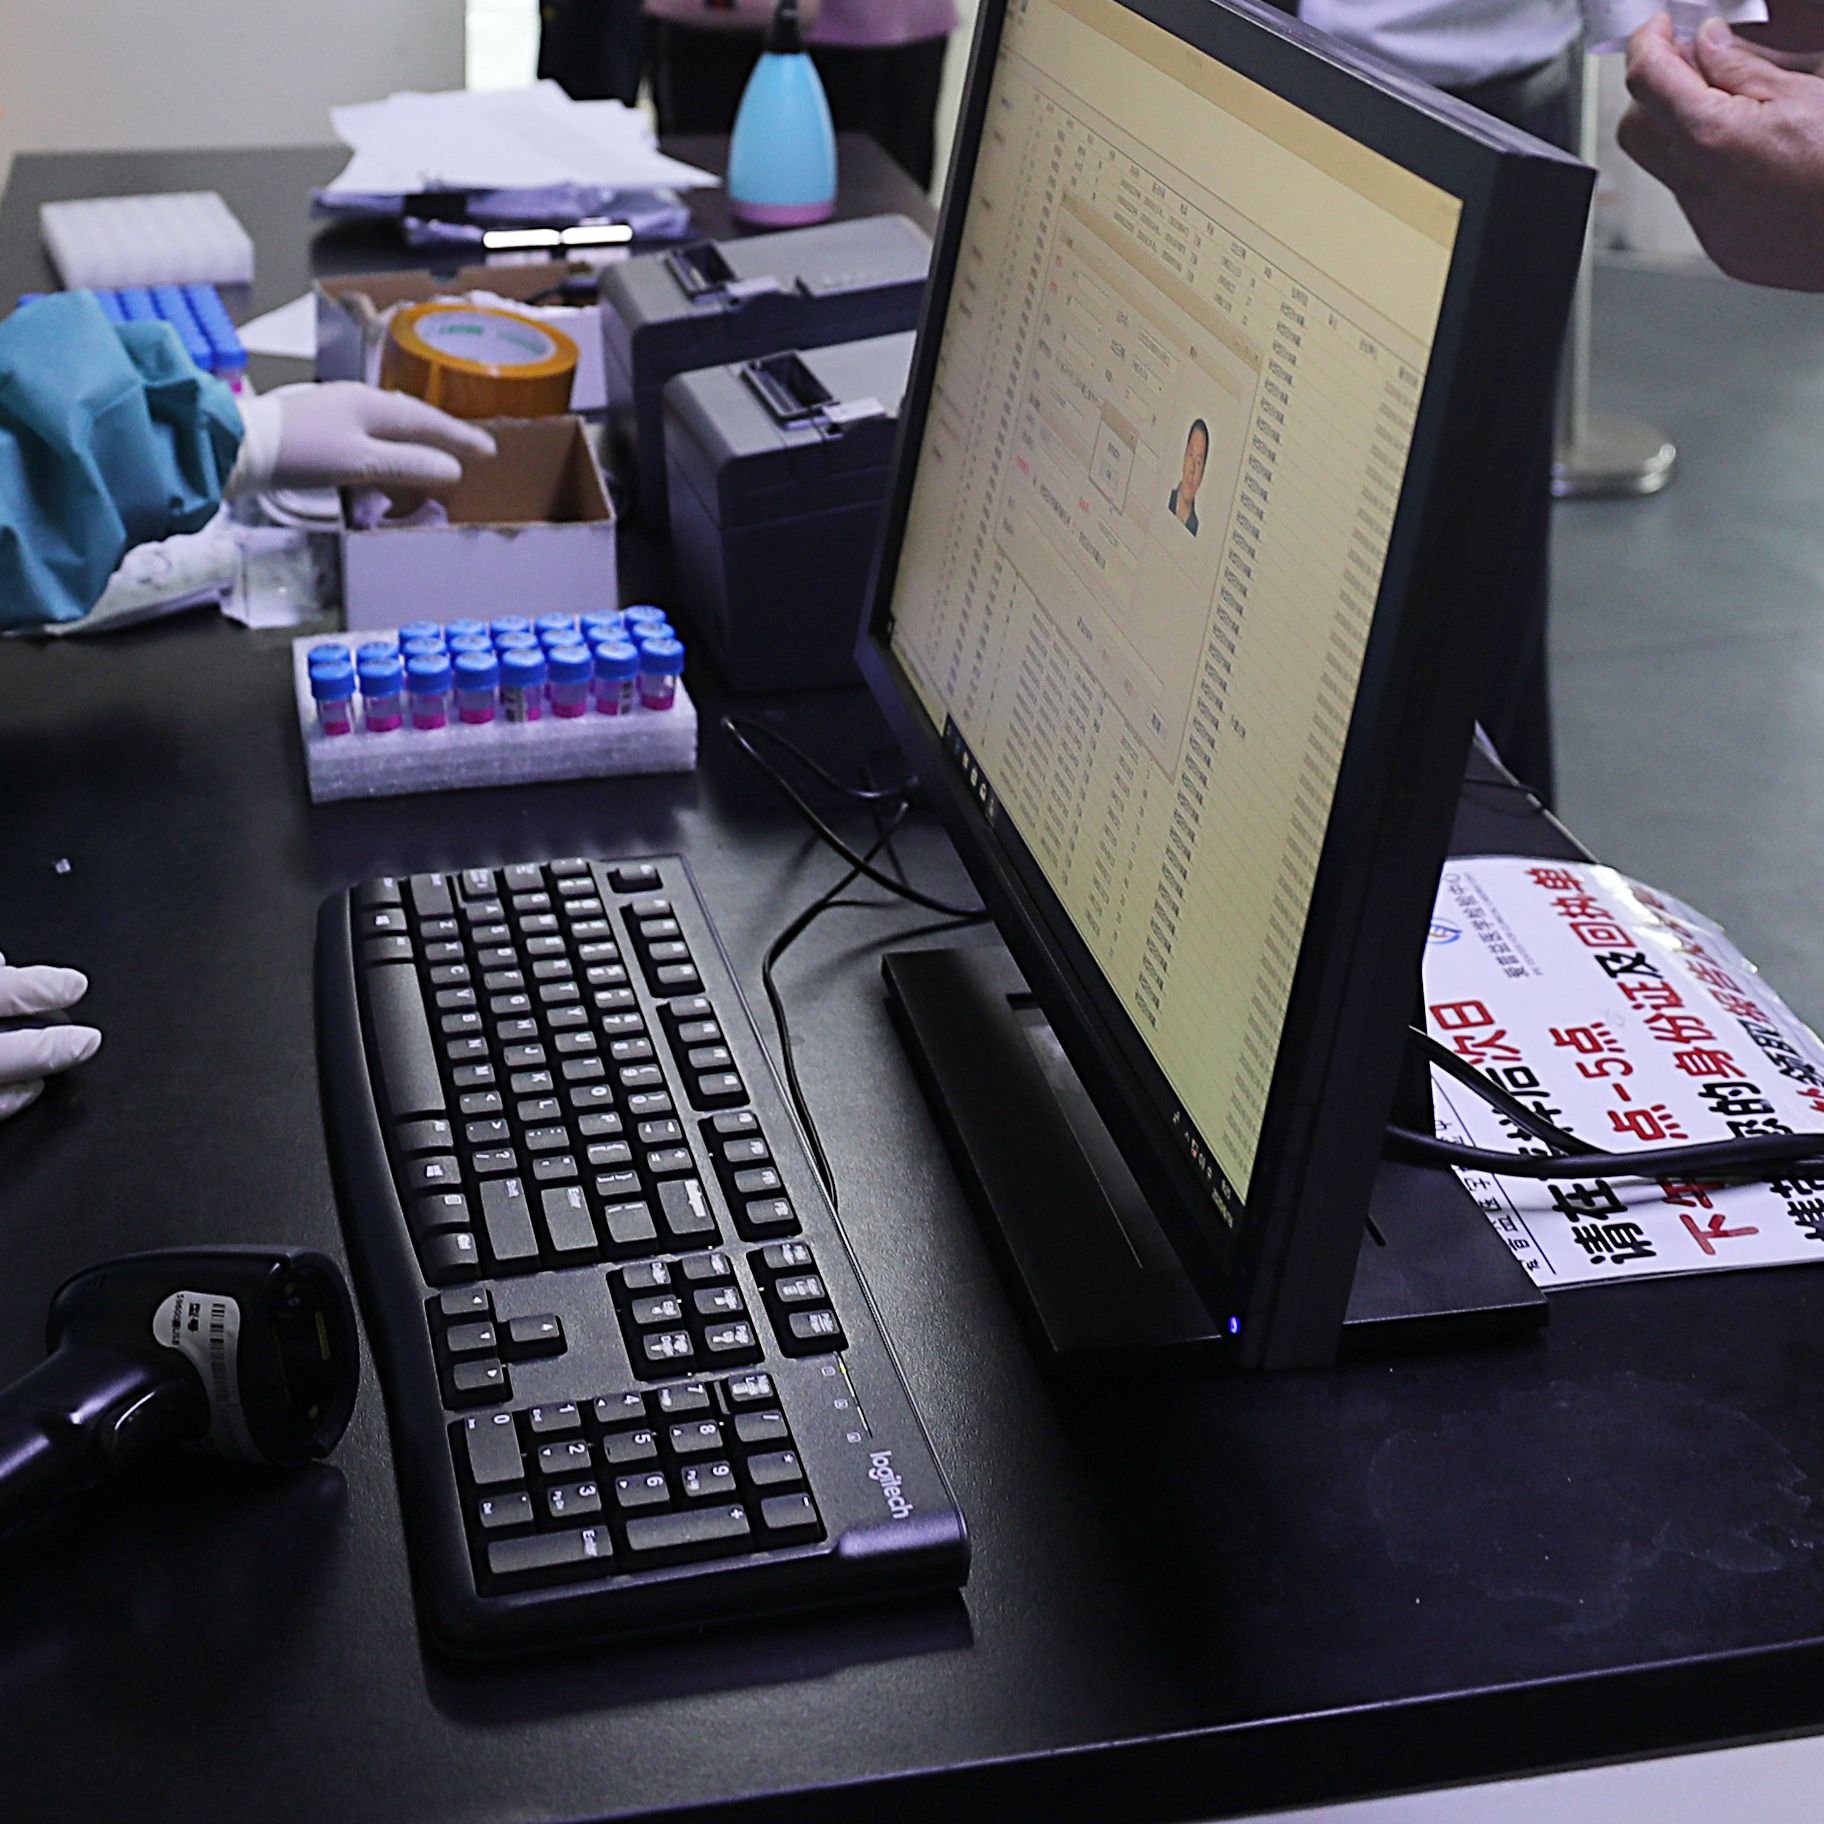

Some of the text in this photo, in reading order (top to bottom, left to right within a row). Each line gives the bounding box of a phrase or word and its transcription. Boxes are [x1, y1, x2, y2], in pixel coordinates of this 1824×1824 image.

[1548, 1022, 1760, 1255] 下午点-5点
[868, 1451, 913, 1519] logitech
